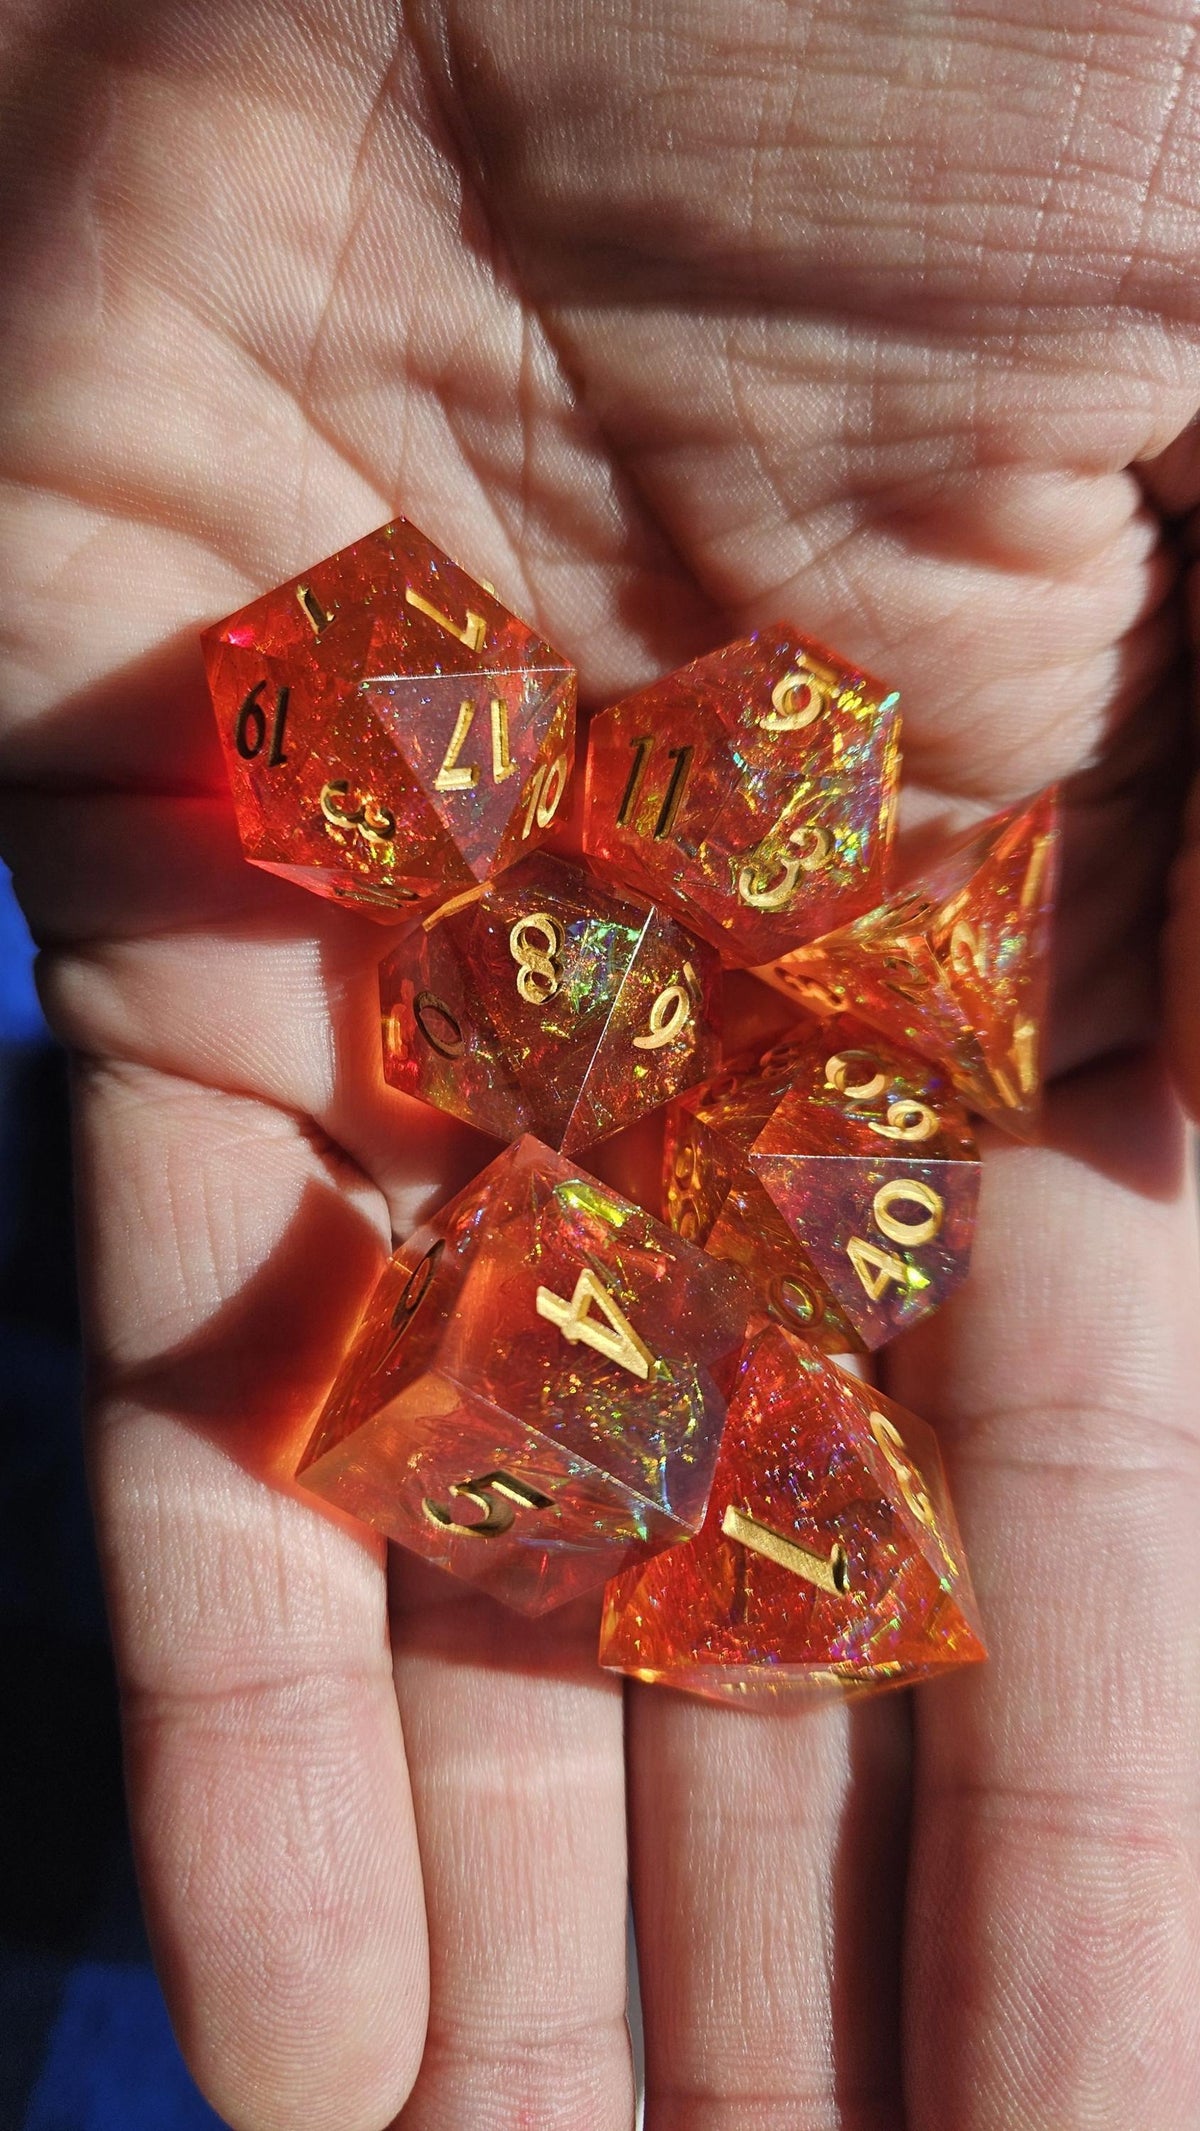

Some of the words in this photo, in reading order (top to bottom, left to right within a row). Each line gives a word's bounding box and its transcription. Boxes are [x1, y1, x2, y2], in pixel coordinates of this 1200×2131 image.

[434, 698, 519, 793] 17
[617, 735, 694, 843] 11
[319, 778, 397, 844] 3
[521, 753, 567, 841] 10
[738, 824, 837, 913] 3
[509, 911, 567, 1006] 8
[412, 989, 466, 1060] 0
[846, 1178, 945, 1302] 40
[536, 1266, 658, 1381] 4
[421, 1469, 558, 1539] 5
[720, 1503, 851, 1598] 1
